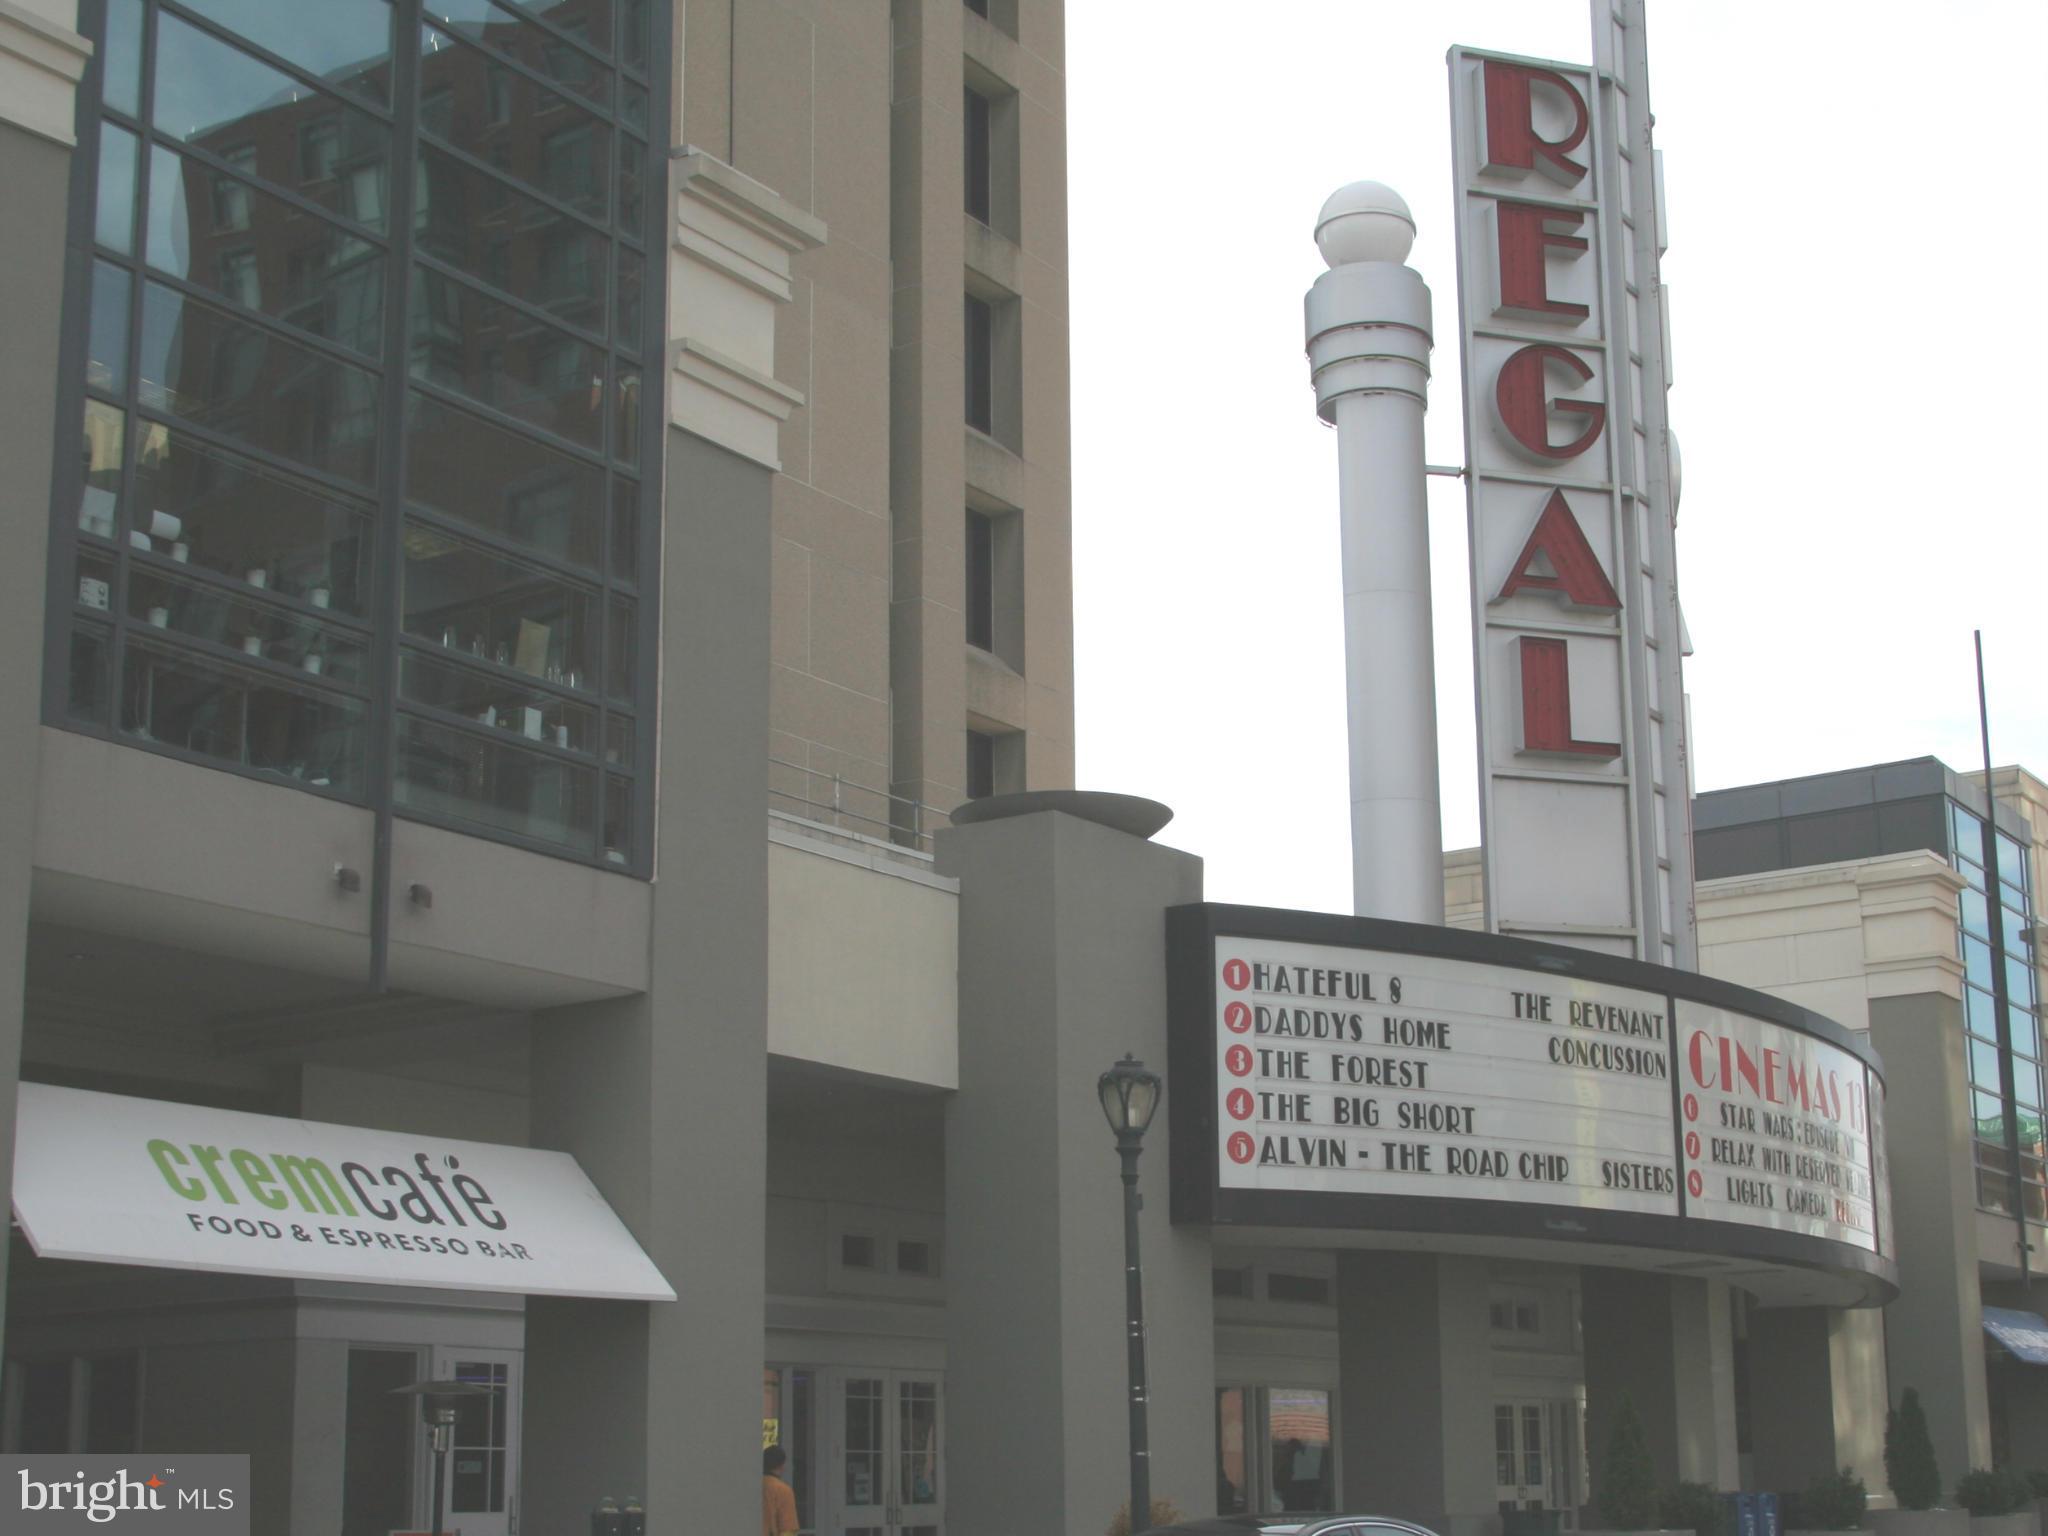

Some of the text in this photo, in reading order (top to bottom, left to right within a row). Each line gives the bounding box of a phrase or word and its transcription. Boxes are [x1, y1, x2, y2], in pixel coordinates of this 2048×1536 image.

[1474, 58, 1624, 762] REGAL
[1253, 963, 1377, 1002] HATEFUL
[1389, 976, 1402, 1005] 8
[1255, 1006, 1364, 1042] DADDYS
[1383, 1016, 1452, 1051] HOME
[1511, 991, 1664, 1041] THE REVENANT
[1257, 1048, 1311, 1081] THE
[1331, 1053, 1429, 1090] FOREST
[1548, 1036, 1667, 1080] CONCUSSION
[1688, 1029, 1866, 1136] CINEMAS 13
[1258, 1091, 1312, 1123] THE
[1333, 1096, 1380, 1128] BIG
[1398, 1101, 1476, 1135] SHORT
[1720, 1101, 1756, 1135] STAR
[1259, 1135, 1347, 1168] ALVIN
[1382, 1142, 1432, 1172] THE
[1446, 1146, 1509, 1179] ROAD
[1518, 1152, 1570, 1183] CHIP
[1602, 1159, 1674, 1194] SISTERS
[1711, 1137, 1755, 1169] RELAX
[1762, 1146, 1791, 1176] WITH
[1726, 1175, 1774, 1209] LIGHTS
[1786, 1187, 1827, 1218] CAMERA
[186, 1212, 534, 1262] FOOD & ESPRESSO BAR
